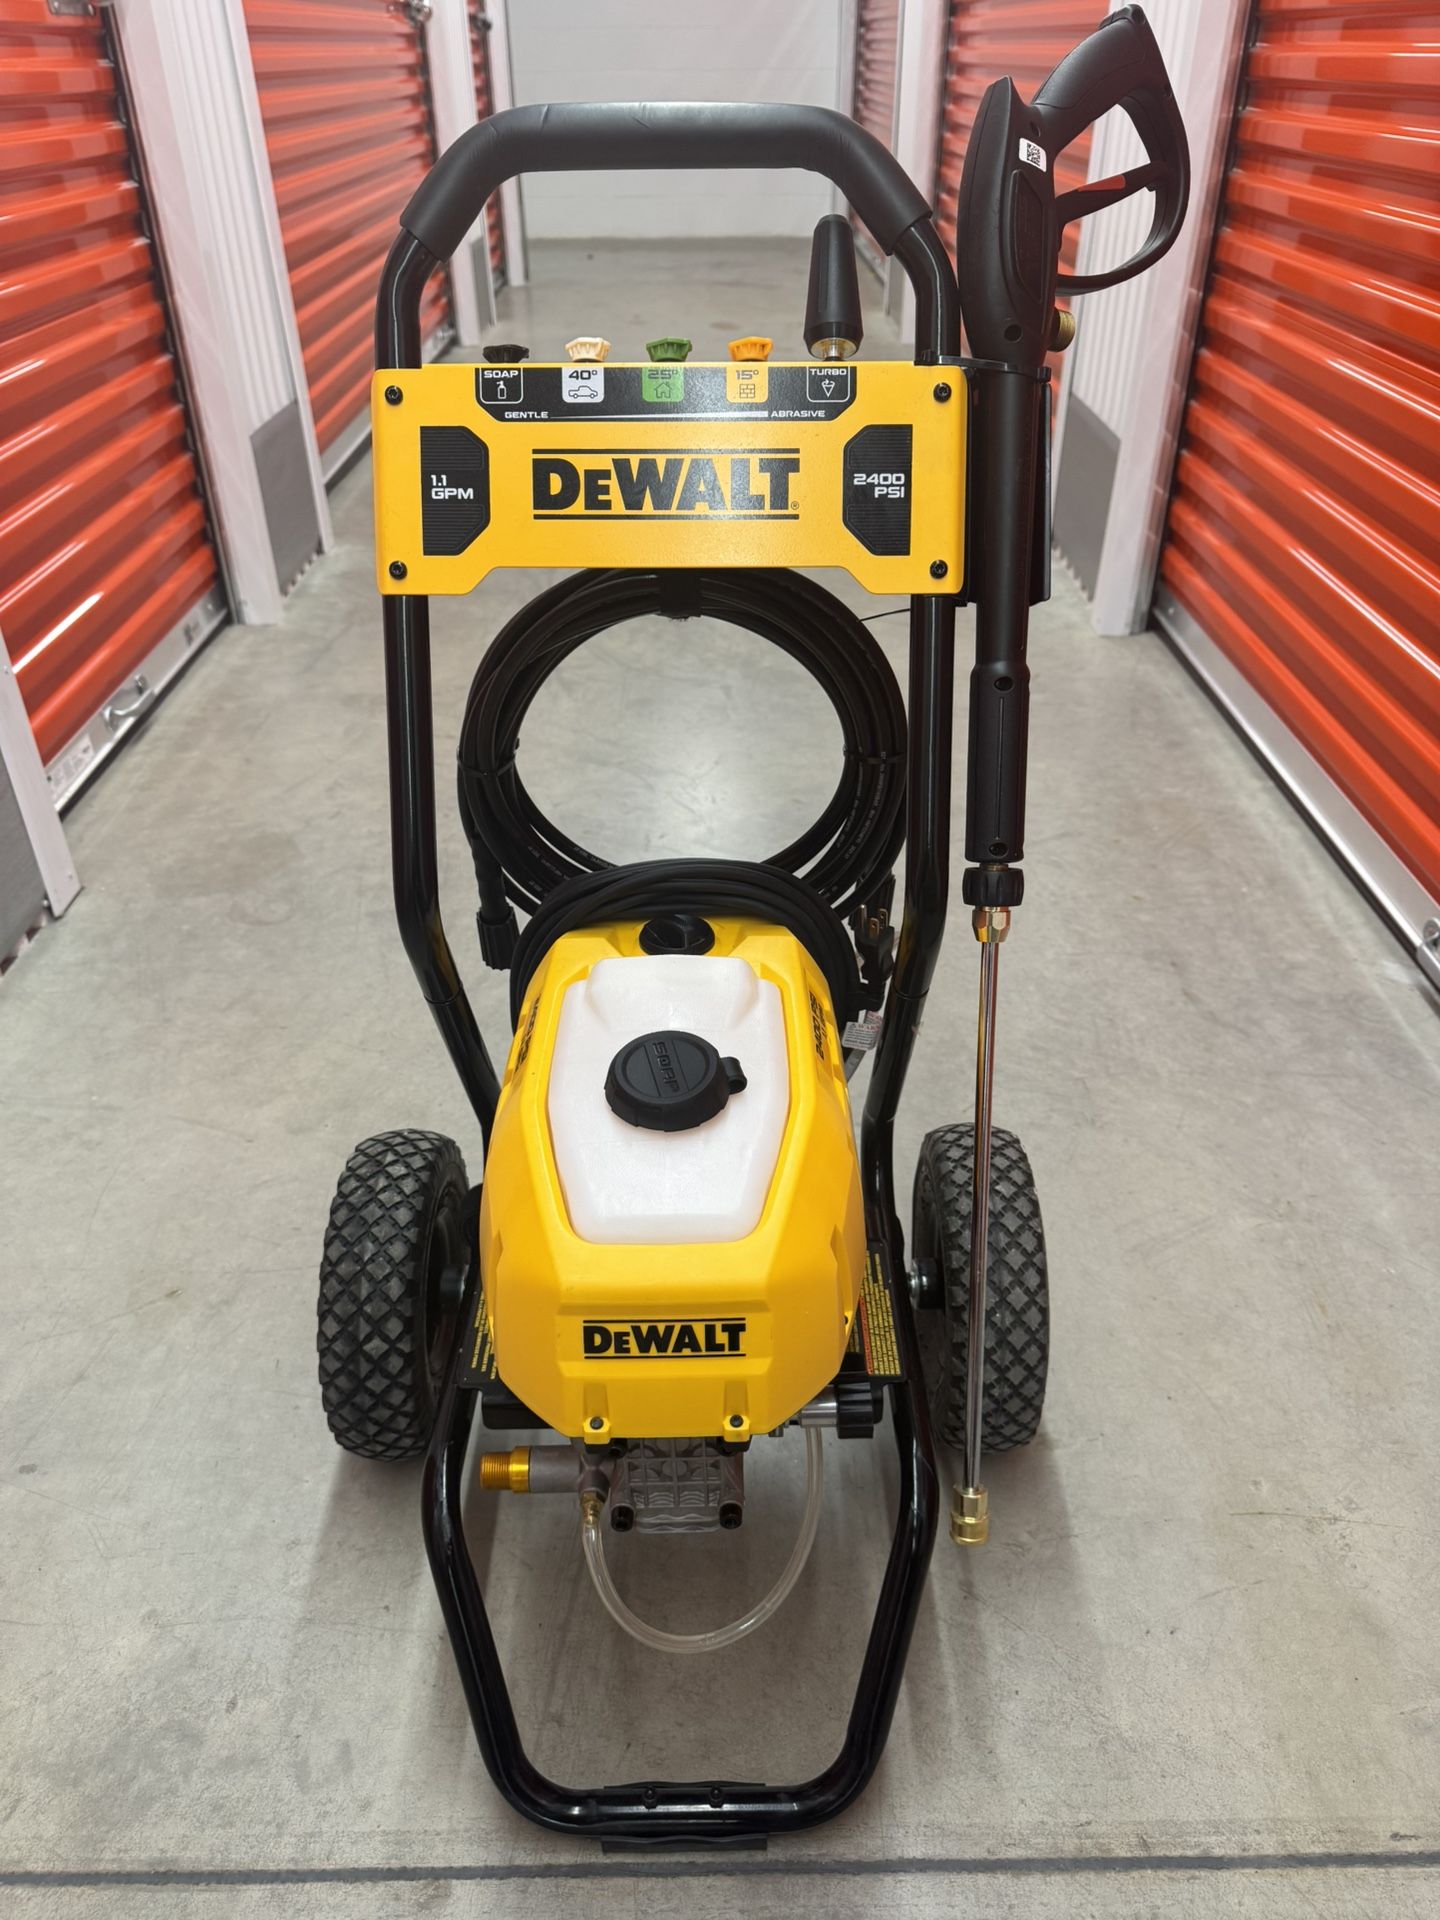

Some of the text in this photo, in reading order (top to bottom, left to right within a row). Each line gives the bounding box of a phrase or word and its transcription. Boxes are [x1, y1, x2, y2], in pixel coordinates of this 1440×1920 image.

[483, 370, 519, 379] SOAP
[568, 369, 598, 381] 40°
[648, 369, 679, 380] 25°
[736, 369, 759, 380] 15°
[809, 368, 847, 376] TURBO
[504, 411, 549, 419] GENTLE
[770, 410, 826, 418] ABRASIVE
[430, 474, 447, 487] 1.1
[853, 473, 905, 486] 2400
[431, 487, 474, 500] GPM
[874, 486, 905, 499] PSI
[652, 1041, 681, 1093] SOAP
